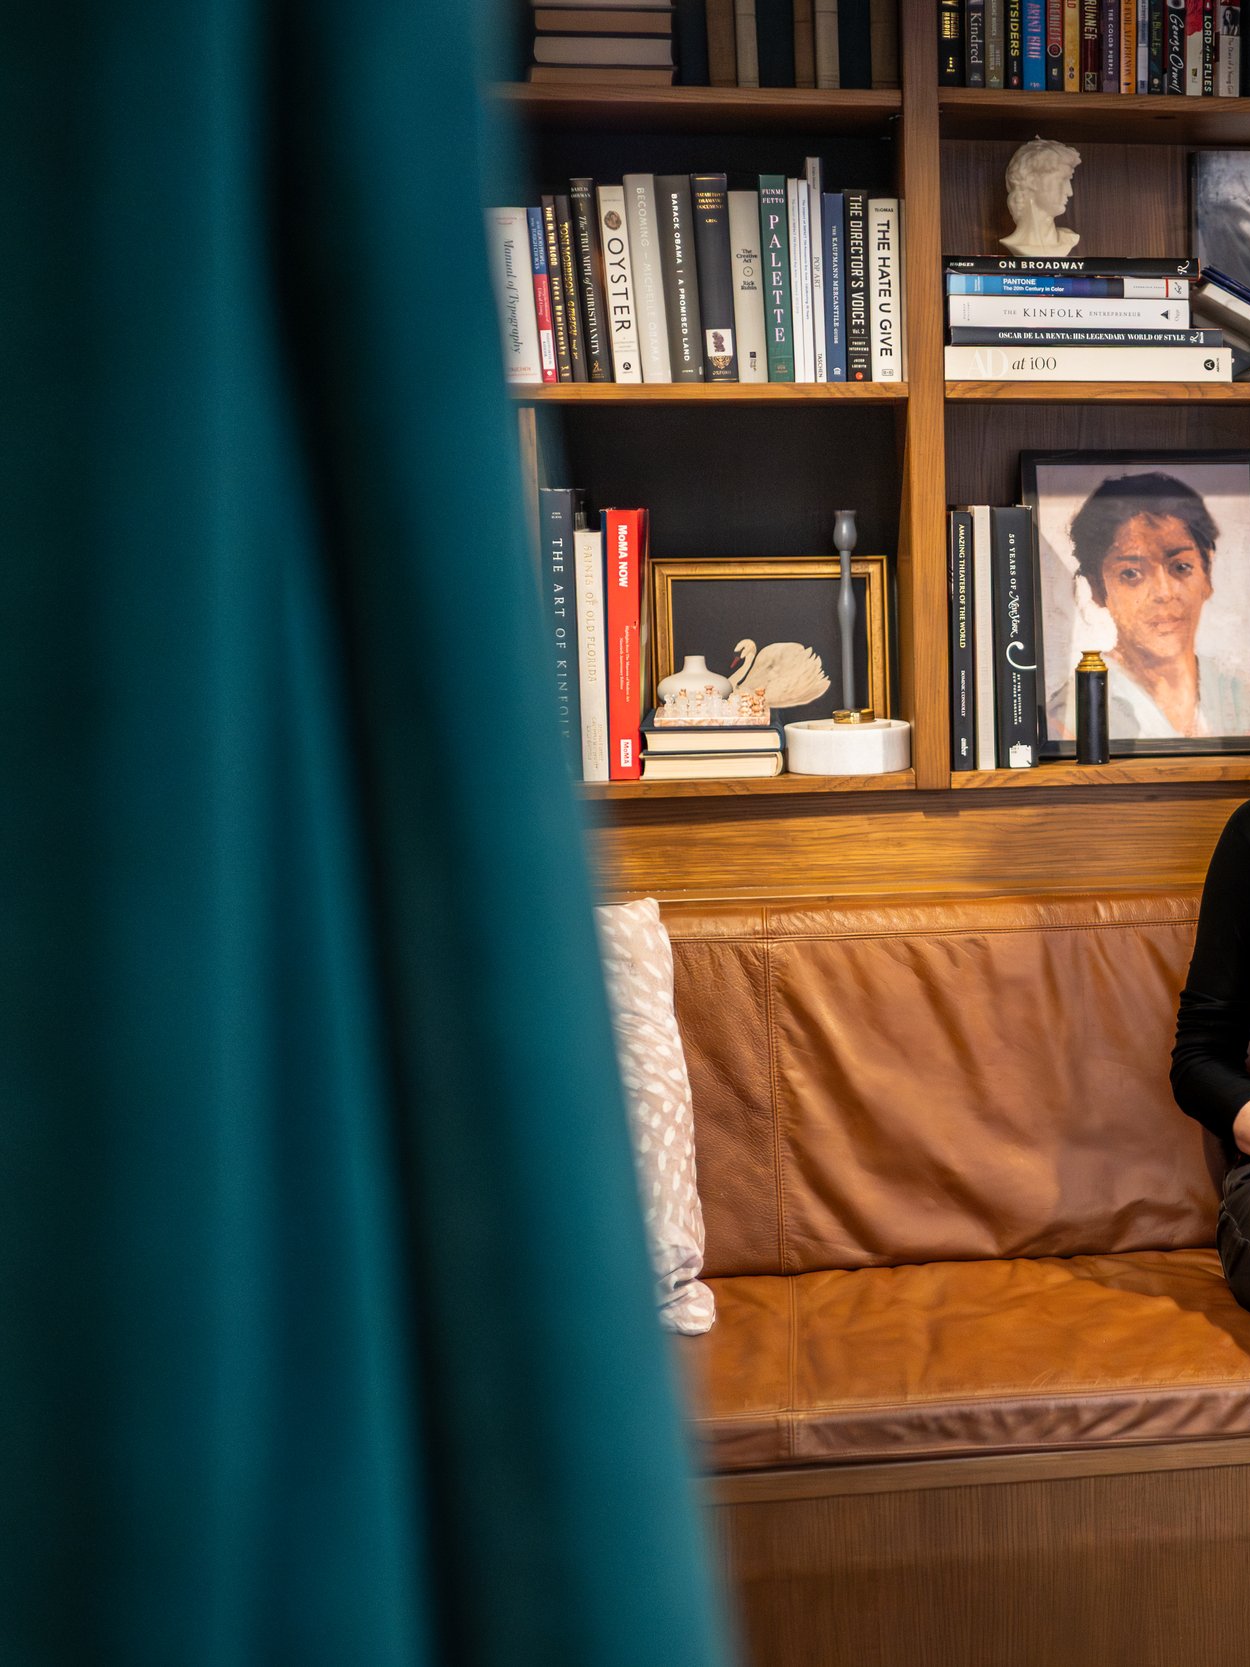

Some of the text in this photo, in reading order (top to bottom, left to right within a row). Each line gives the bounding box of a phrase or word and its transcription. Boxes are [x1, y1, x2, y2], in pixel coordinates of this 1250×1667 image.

[969, 12, 982, 64] Kindred
[1169, 14, 1184, 93] George Orwell
[671, 193, 680, 229] BARACK
[559, 222, 574, 295] TONI MORRISON
[674, 233, 682, 264] OBAMA
[849, 195, 864, 325] THE DIRECTOR'S VOICE
[999, 261, 1084, 270] ON BROADWAY
[578, 215, 599, 355] The TRIUMPH CHRISTIANITY
[607, 238, 631, 332] OYSTER
[636, 187, 659, 362] BECOMING MICHELLE OBAMA
[769, 214, 785, 343] PALETTE
[877, 220, 893, 356] THE HATE U GIVE
[503, 239, 523, 354] Manual Typography
[679, 289, 688, 334] PROMISED
[1023, 308, 1084, 318] KINFOLK
[682, 338, 690, 361] LAND
[1046, 332, 1072, 340] RENTA:
[1128, 333, 1151, 341] WORLD
[1011, 357, 1027, 371] at
[552, 538, 563, 572] THE
[617, 525, 628, 587] MoMA NOW
[958, 524, 966, 558] AMAZING
[958, 559, 966, 593] THEATERS
[1008, 533, 1017, 590] 50 YEARS OF
[554, 584, 565, 617] ART
[583, 545, 597, 683] SAINTS OF OLD FLORIDA
[959, 594, 966, 605] OF
[555, 628, 566, 649] OF
[959, 621, 967, 648] WORLD
